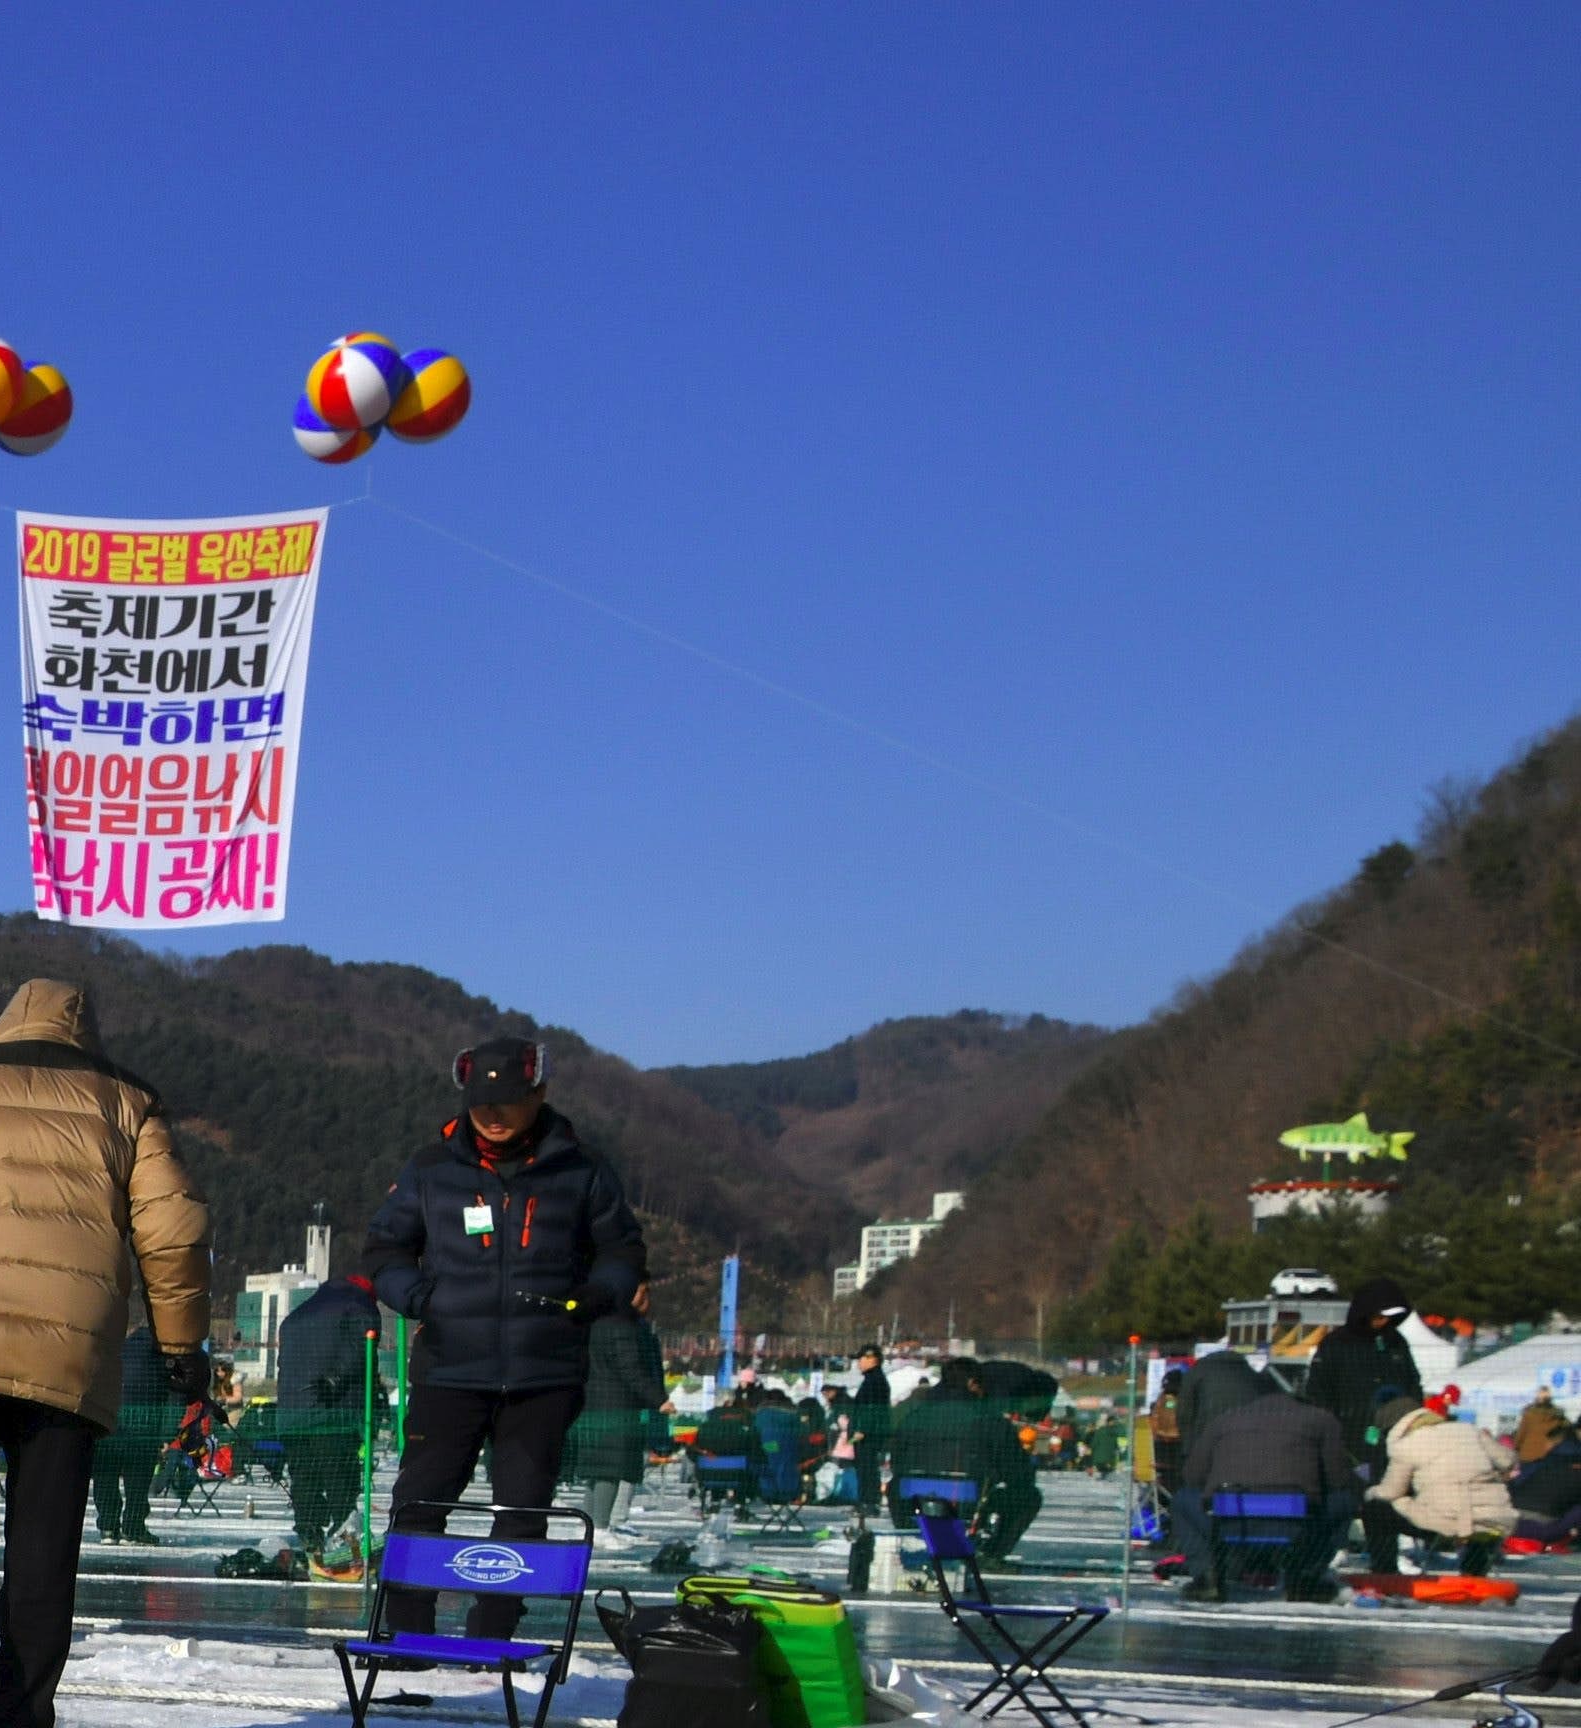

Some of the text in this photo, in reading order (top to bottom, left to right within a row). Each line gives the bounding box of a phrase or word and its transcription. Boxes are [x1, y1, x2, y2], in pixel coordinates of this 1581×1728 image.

[26, 525, 311, 584] 2019 글로벌 육성축제
[48, 589, 275, 640] 축제기간
[42, 643, 270, 695] 화천에서
[22, 692, 285, 746] 숙박하면
[158, 832, 280, 919] 공짜!
